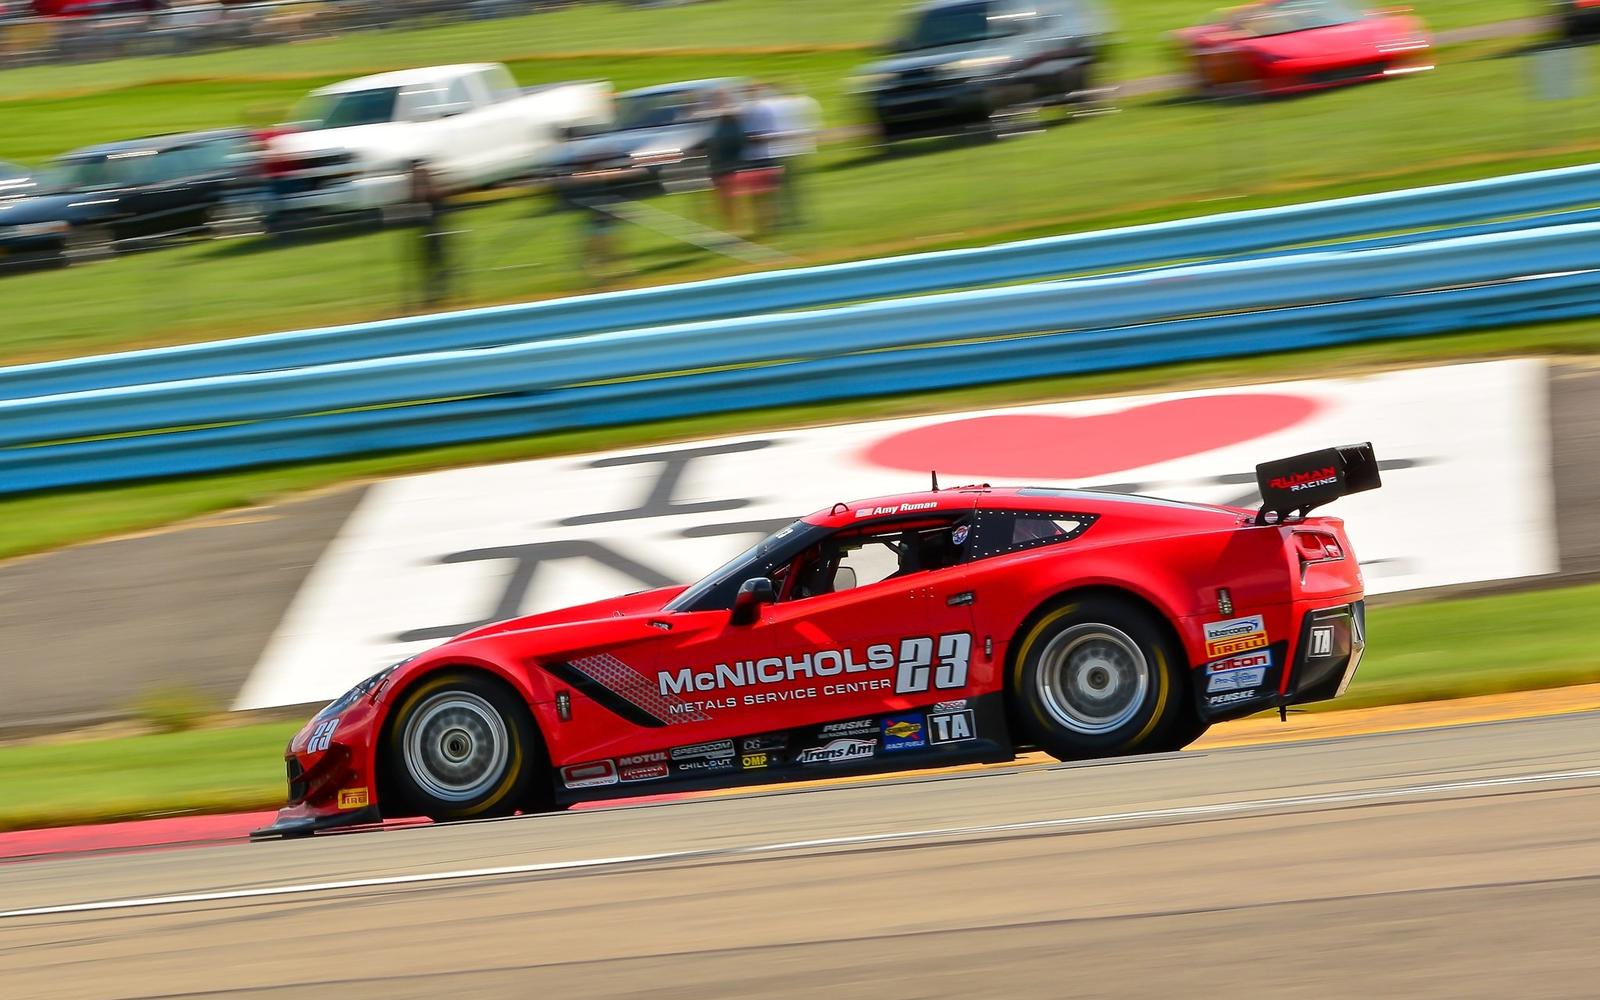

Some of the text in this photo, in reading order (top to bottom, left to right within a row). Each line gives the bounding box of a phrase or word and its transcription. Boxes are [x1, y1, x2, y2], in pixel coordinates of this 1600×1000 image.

[1268, 466, 1337, 489] RUMAN
[1291, 476, 1337, 492] RACING
[873, 501, 938, 516] Amy Ruman
[1207, 633, 1266, 656] PIRELLI
[1313, 629, 1331, 654] TA
[658, 632, 972, 696] McNICHOLS 23
[668, 678, 892, 715] METALS SERVICE CENTER
[823, 719, 873, 733] PENSKE
[932, 713, 971, 741] TA
[306, 718, 340, 755] 23
[672, 741, 732, 757] SPEEDCOM
[797, 743, 874, 762] Trans Am
[619, 751, 668, 767] MOTUL
[679, 758, 732, 771] CHILLOUT
[742, 754, 768, 768] OMP
